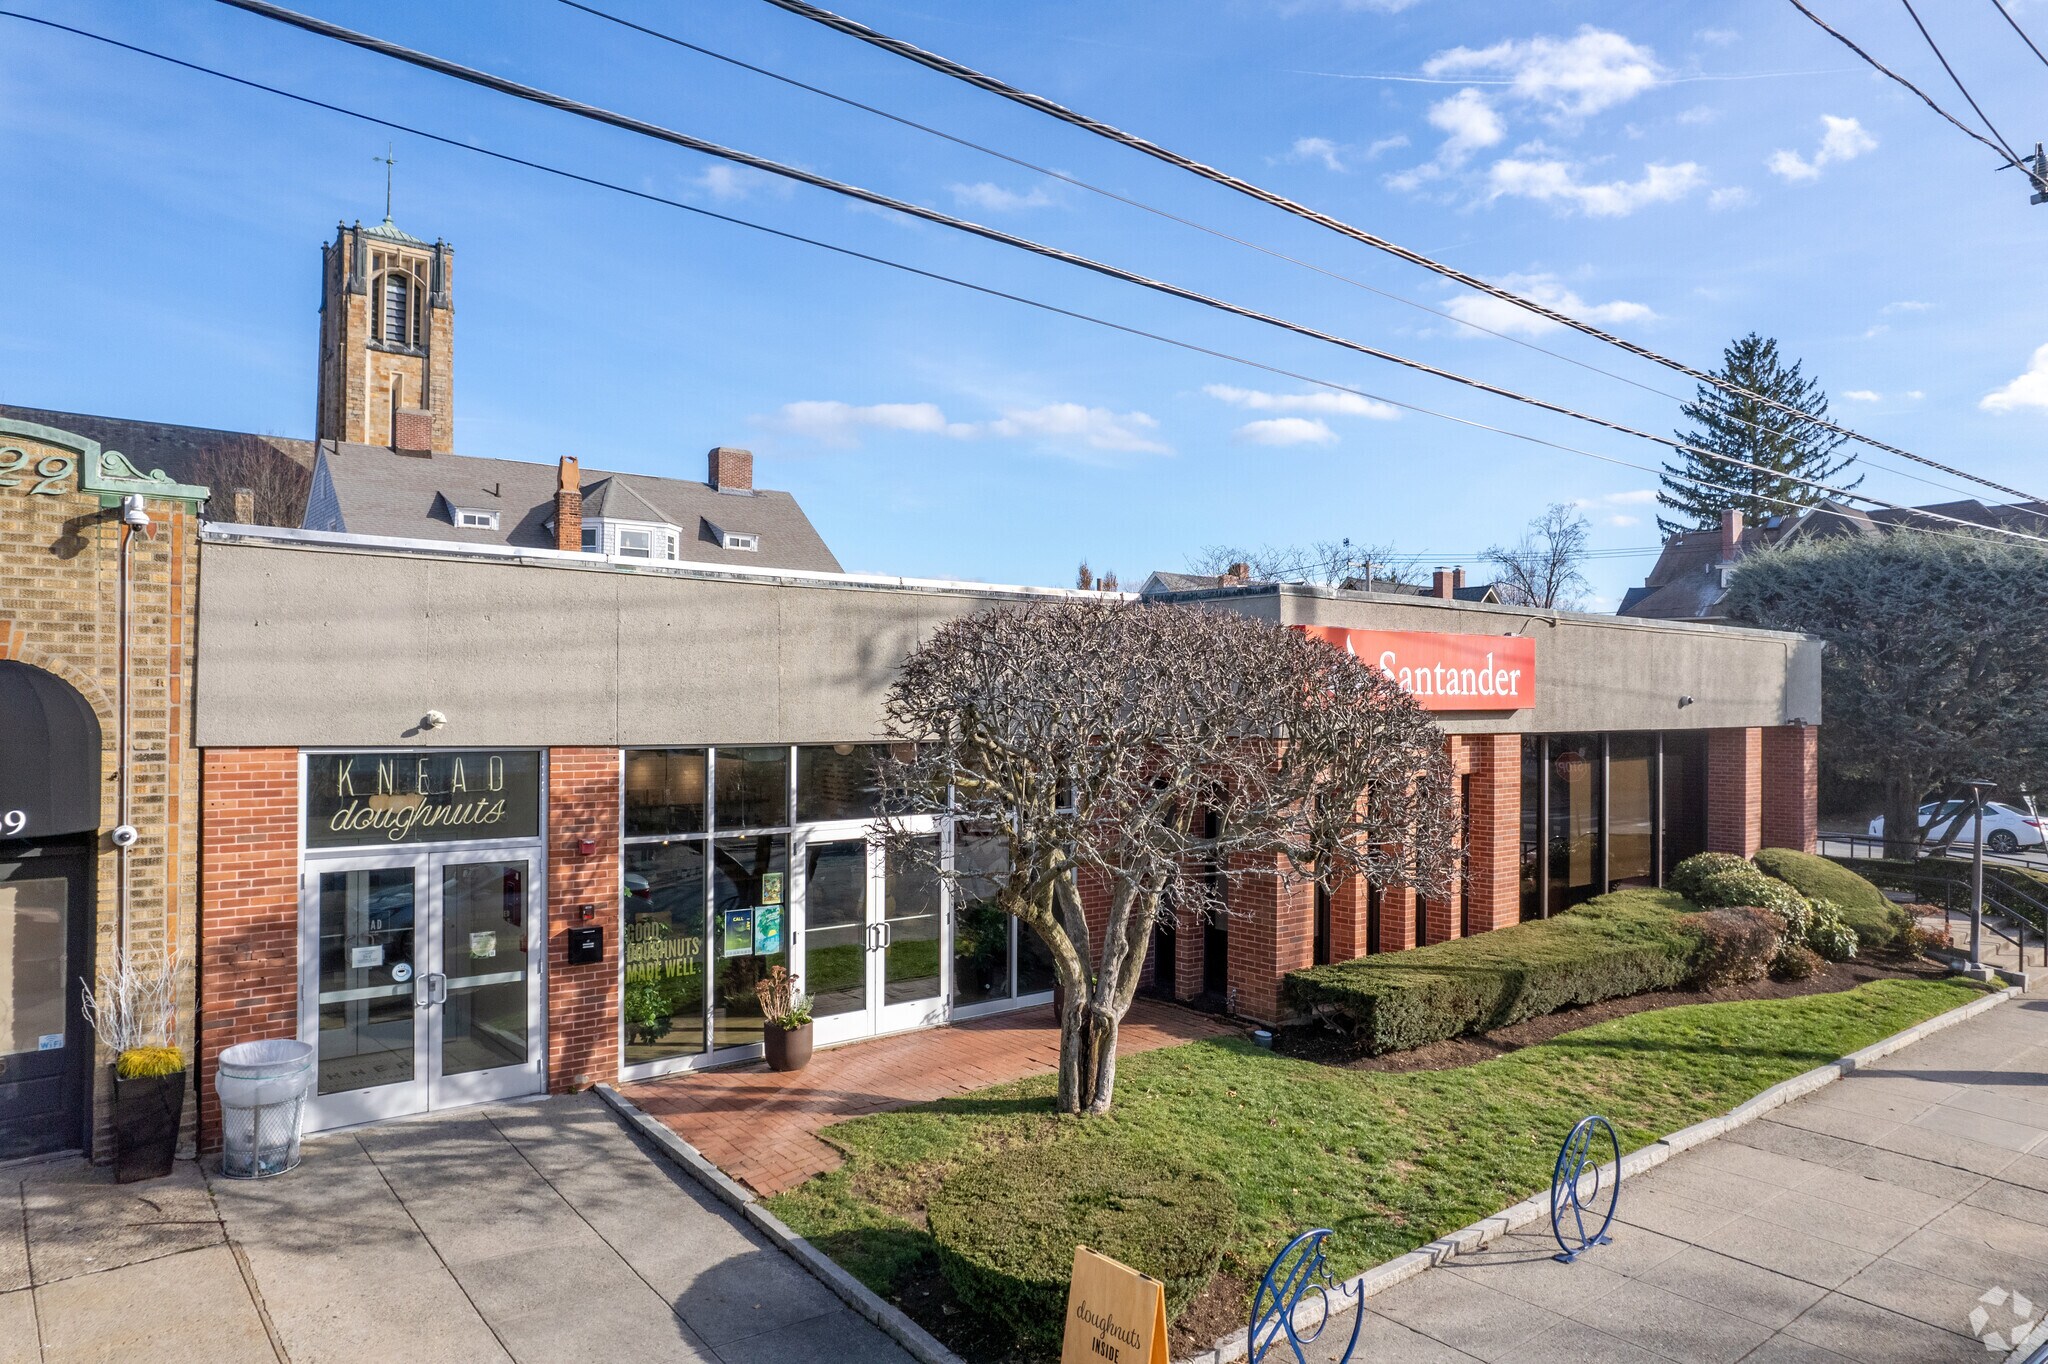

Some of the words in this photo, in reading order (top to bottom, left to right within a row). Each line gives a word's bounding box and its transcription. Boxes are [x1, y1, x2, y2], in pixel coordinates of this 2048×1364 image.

[1379, 650, 1520, 696] Santander
[0, 810, 26, 835] 9
[330, 797, 506, 841] doughnuts
[627, 921, 660, 943] GOOD
[627, 937, 700, 962] DOUGHNUTS
[627, 961, 661, 983] MADE
[1076, 1299, 1141, 1350] doughnuts
[1091, 1336, 1120, 1364] INSIDE
